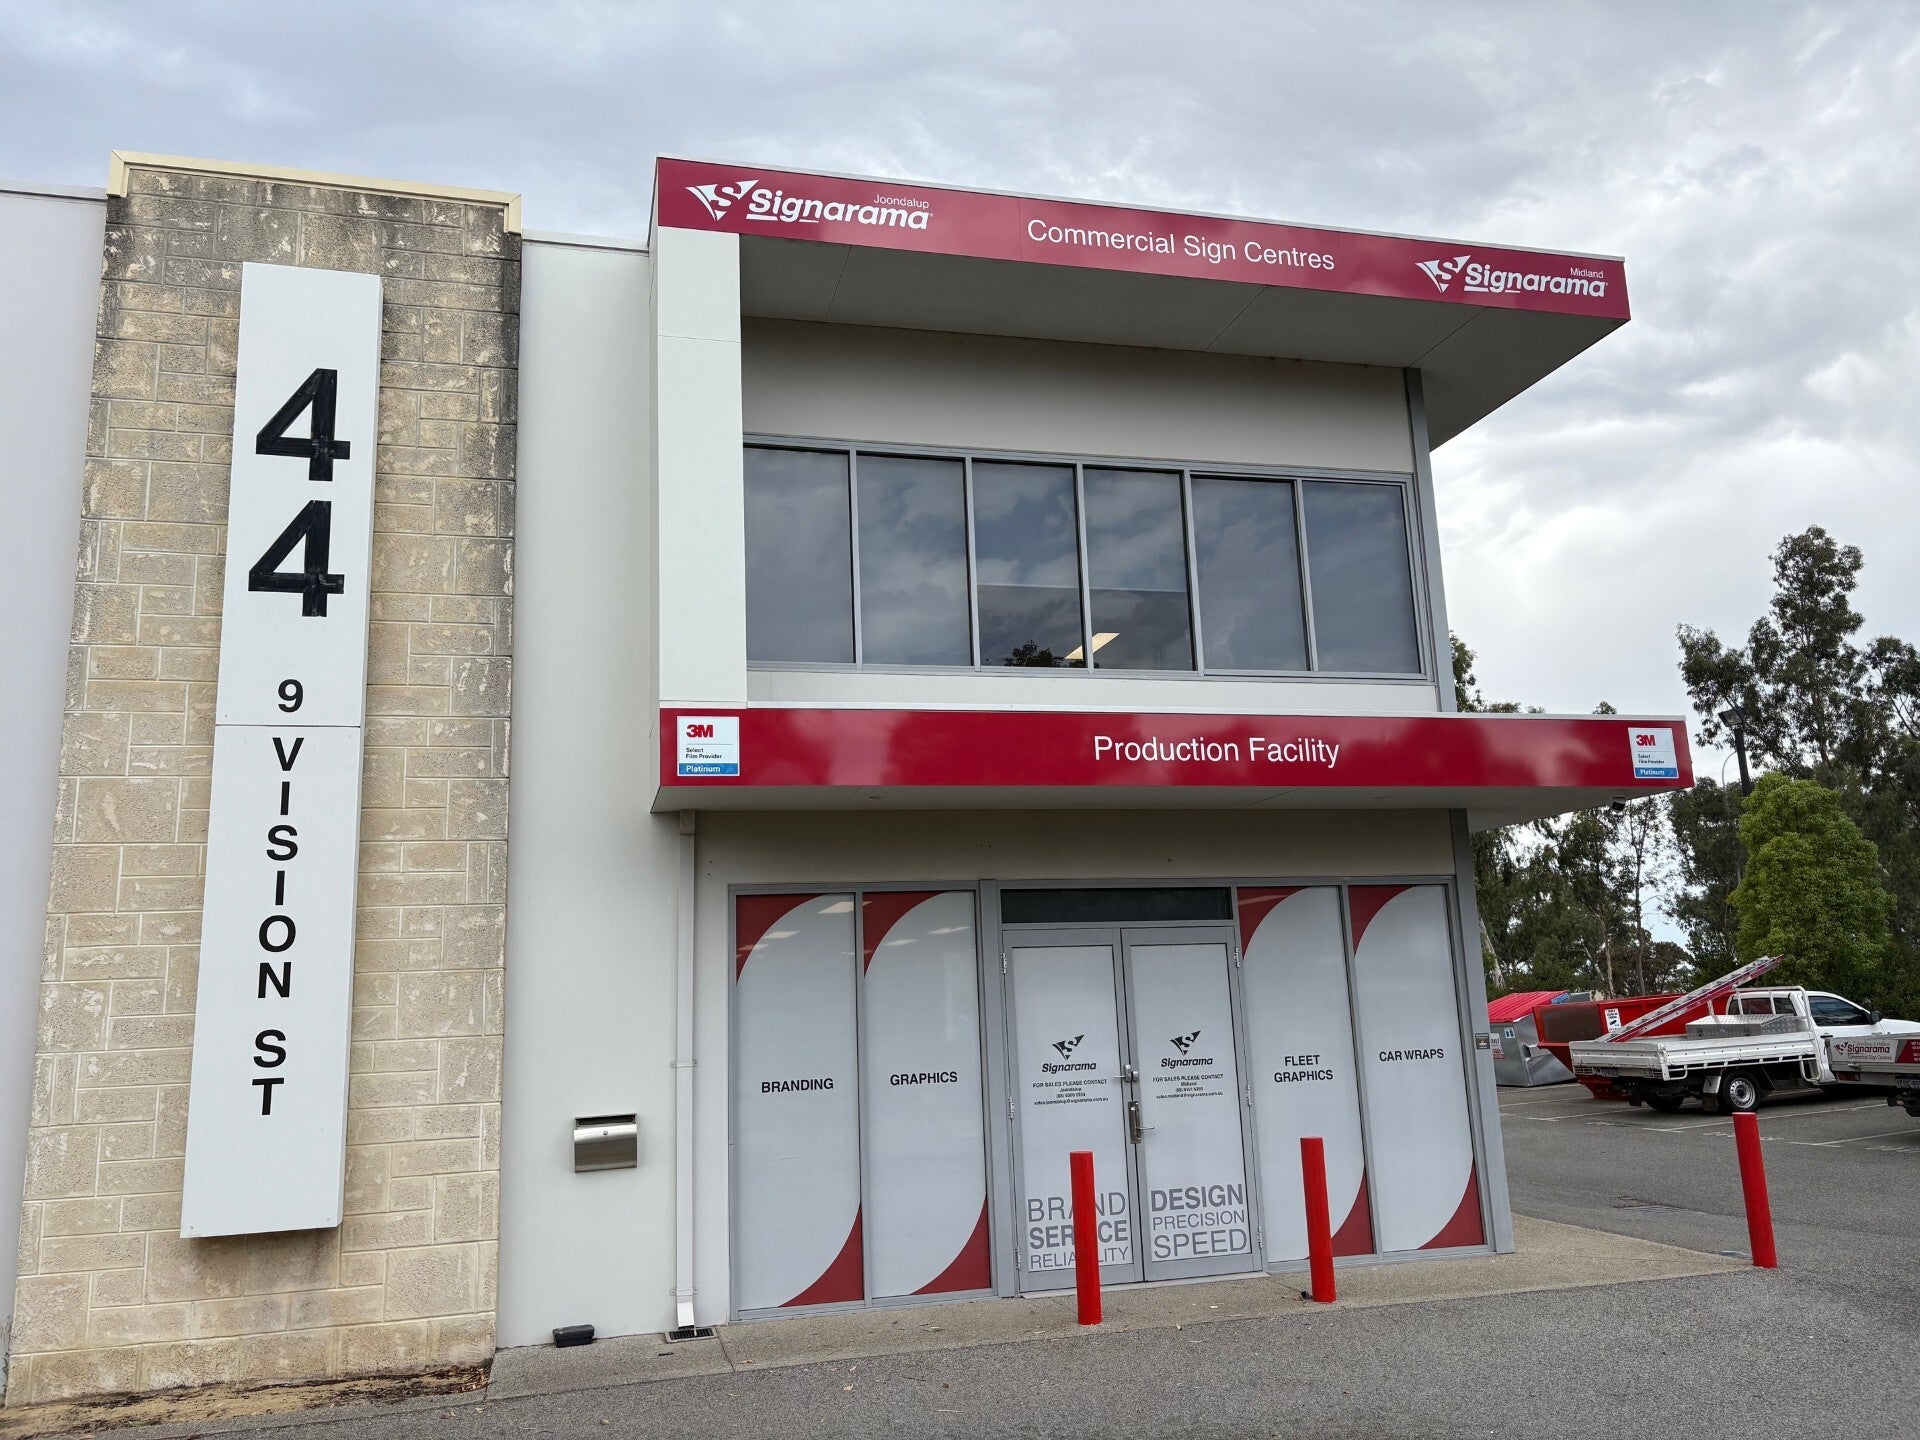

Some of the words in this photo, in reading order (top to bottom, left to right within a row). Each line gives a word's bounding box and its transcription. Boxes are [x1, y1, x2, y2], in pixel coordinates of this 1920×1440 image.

[747, 188, 930, 230] Signarama
[873, 193, 930, 210] Joondalup
[1027, 219, 1175, 254] Commercial
[1184, 235, 1237, 264] Sign
[1244, 241, 1335, 271] Centres
[1464, 263, 1608, 298] Signarama
[1570, 267, 1604, 279] Midland
[277, 679, 304, 713] 9
[686, 724, 714, 738] 3M
[1636, 734, 1656, 747] 3M
[1093, 735, 1239, 762] Production
[1248, 737, 1340, 769] Facility
[686, 765, 721, 773] Platinum
[257, 737, 305, 999] VISION
[1379, 1051, 1403, 1062] CAR
[1404, 1048, 1444, 1061] WRAPS
[1847, 1043, 1891, 1054] Signarama
[1041, 1061, 1097, 1075] Signarama
[1160, 1057, 1214, 1070] Signarama
[1284, 1054, 1321, 1067] FLEET
[251, 1028, 287, 1116] ST
[889, 1071, 958, 1086] GRAPHICS
[1273, 1069, 1334, 1083] GRAPHICS
[761, 1077, 834, 1094] BRANDING
[1028, 1191, 1126, 1222] BRND
[1150, 1184, 1244, 1212] DESIGN
[1152, 1209, 1245, 1231] PRECISION
[1029, 1220, 1128, 1249] SERCE
[1153, 1228, 1248, 1259] SPEED
[1030, 1246, 1128, 1269] RELIAITY
